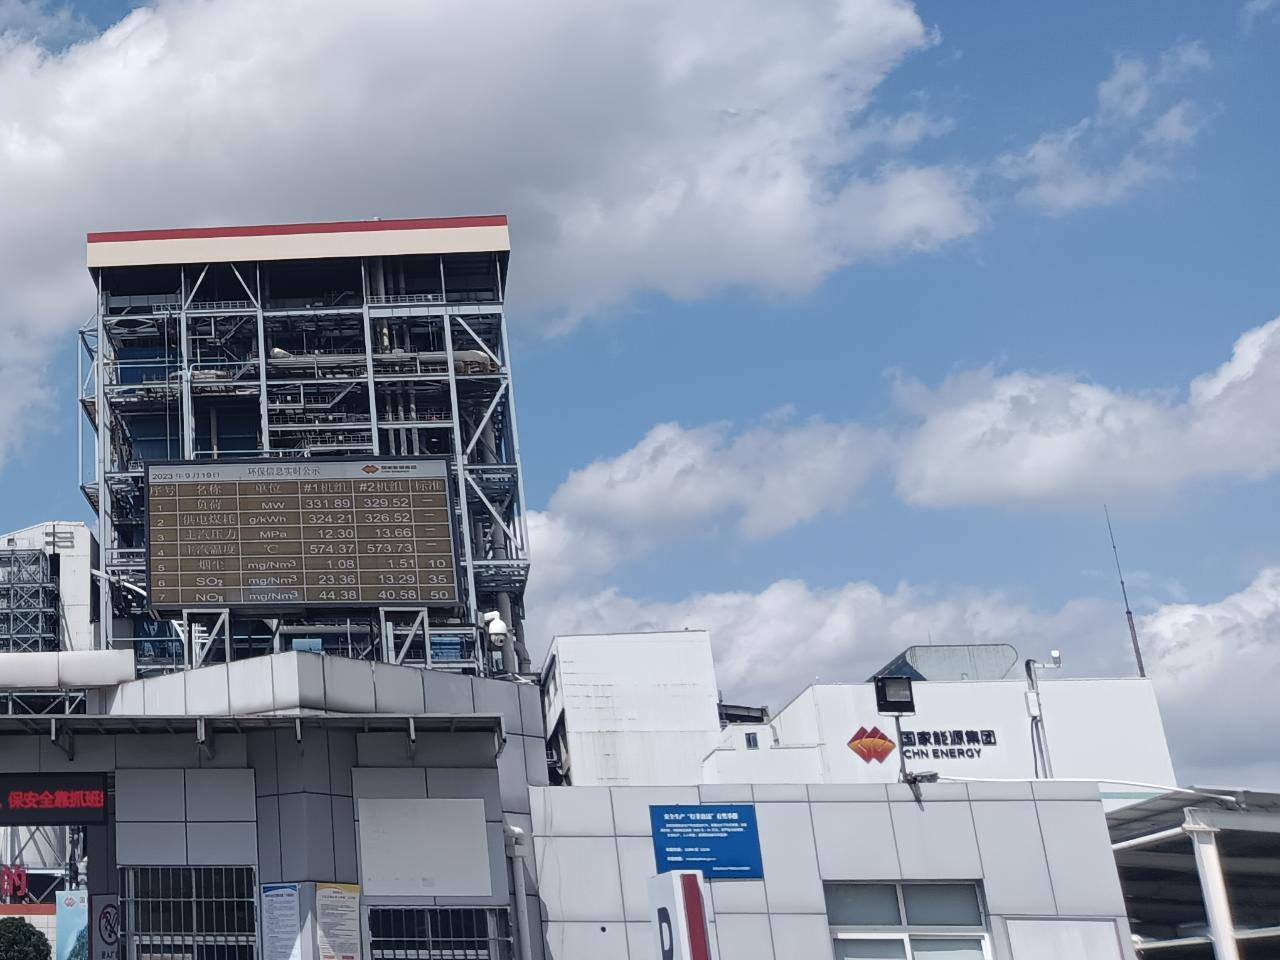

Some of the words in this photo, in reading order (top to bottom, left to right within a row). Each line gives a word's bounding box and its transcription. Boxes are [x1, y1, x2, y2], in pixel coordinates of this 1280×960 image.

[247, 466, 321, 477] 环保信息实时公示
[305, 498, 350, 508] 331.89
[364, 498, 409, 507] 329.52
[249, 515, 286, 524] g/kWh
[308, 513, 353, 523] 324.21
[365, 513, 410, 522] 326.52
[260, 530, 287, 538] MPa
[318, 528, 353, 538] 12.30
[375, 528, 411, 537] 13.66
[310, 543, 355, 553] 574.37
[367, 543, 412, 553] 573.73
[327, 560, 354, 569] 1.08
[387, 559, 414, 568] 1.51
[428, 559, 446, 568] 10
[318, 575, 355, 584] 23.36
[378, 575, 415, 584] 13.29
[428, 575, 447, 583] 35
[159, 593, 166, 601] 7
[319, 590, 356, 599] 44.38
[378, 590, 416, 599] 40.58
[429, 590, 448, 599] 50
[900, 730, 996, 746] 国家能源集团
[902, 748, 930, 759] CHN
[932, 748, 982, 759] ENERGY
